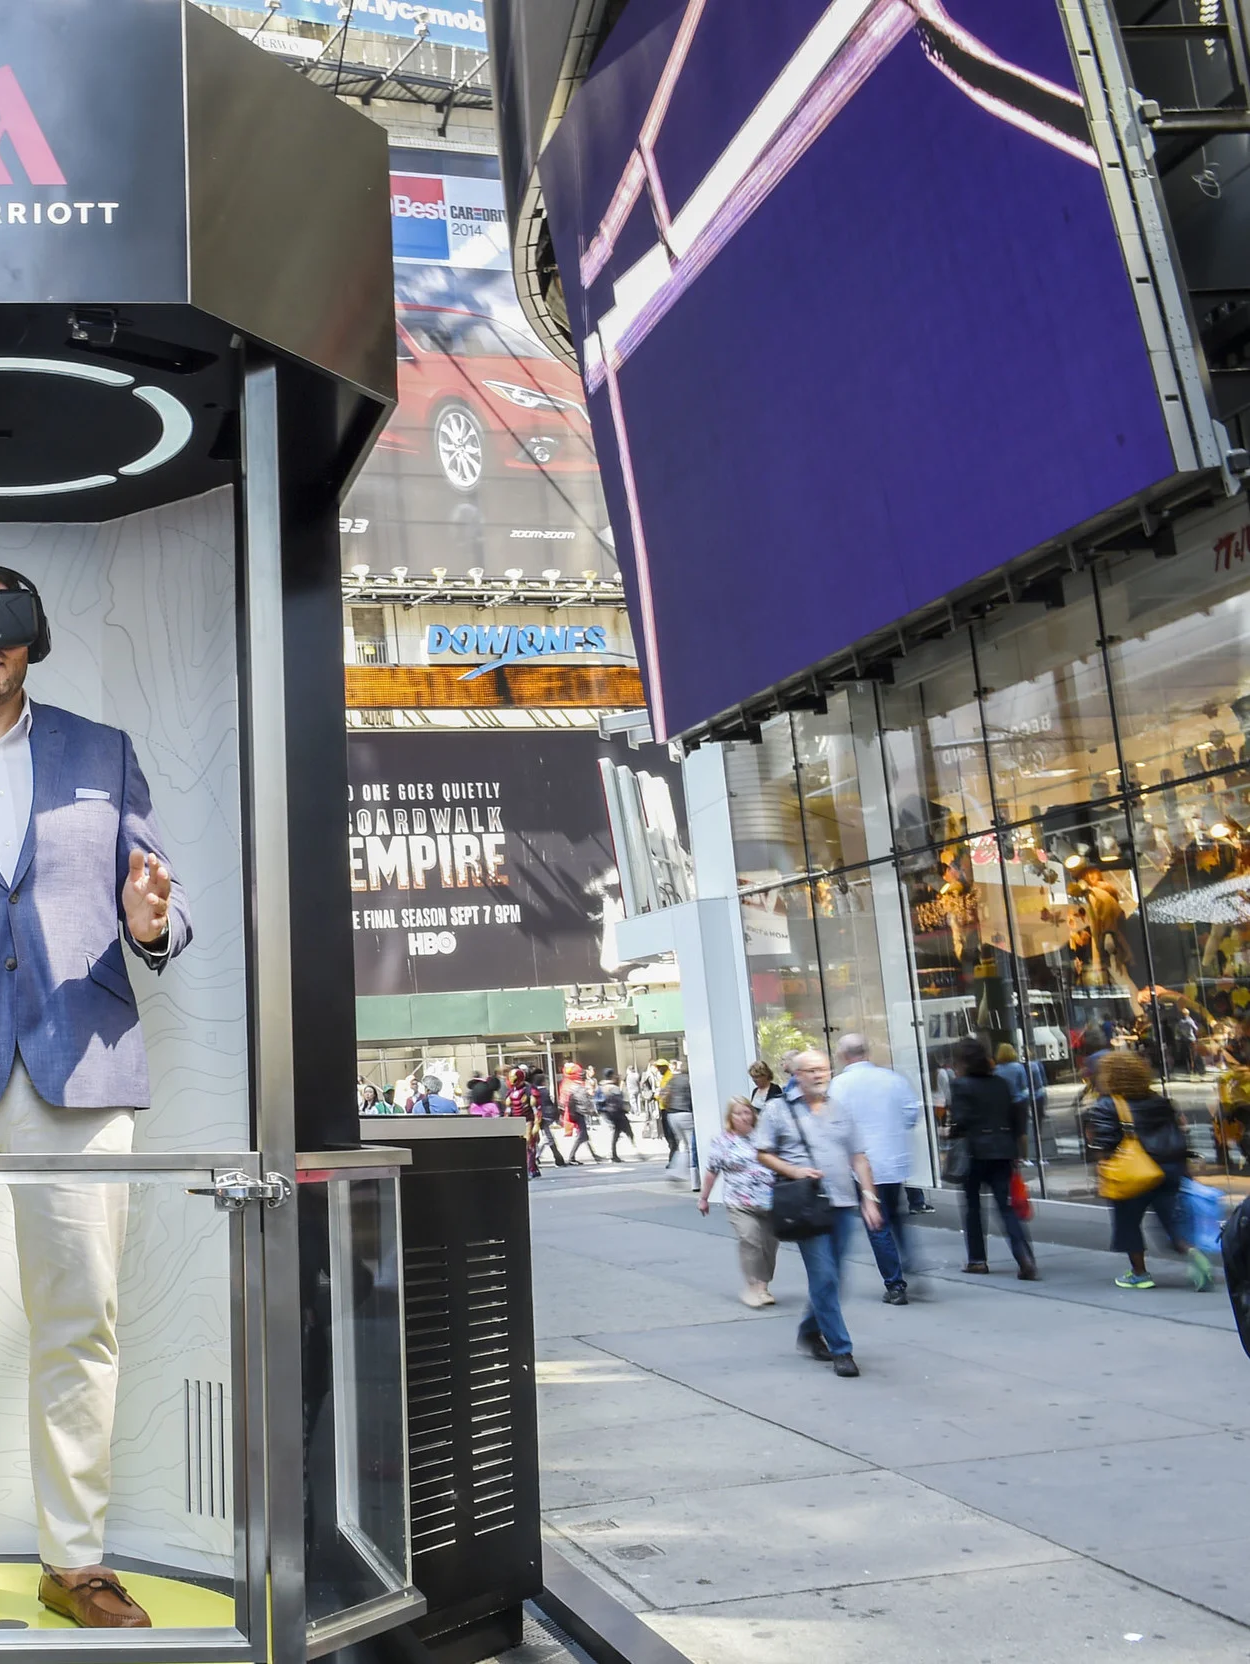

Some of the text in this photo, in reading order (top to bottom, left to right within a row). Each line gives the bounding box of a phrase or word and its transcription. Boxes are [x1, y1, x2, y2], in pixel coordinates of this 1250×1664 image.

[390, 195, 446, 220] Best
[450, 205, 474, 220] CAR
[452, 223, 482, 236] 2014
[362, 784, 390, 801] ONE
[399, 783, 434, 800] GOES
[442, 782, 500, 802] QUIETLY
[348, 806, 504, 836] OARDWALK
[349, 833, 510, 892] EMPIRE
[363, 908, 399, 929] FINAL
[401, 907, 447, 928] SEASON
[450, 905, 480, 926] SEPT
[482, 905, 491, 924] 7
[494, 904, 522, 924] 9PM
[407, 931, 457, 956] HBO
